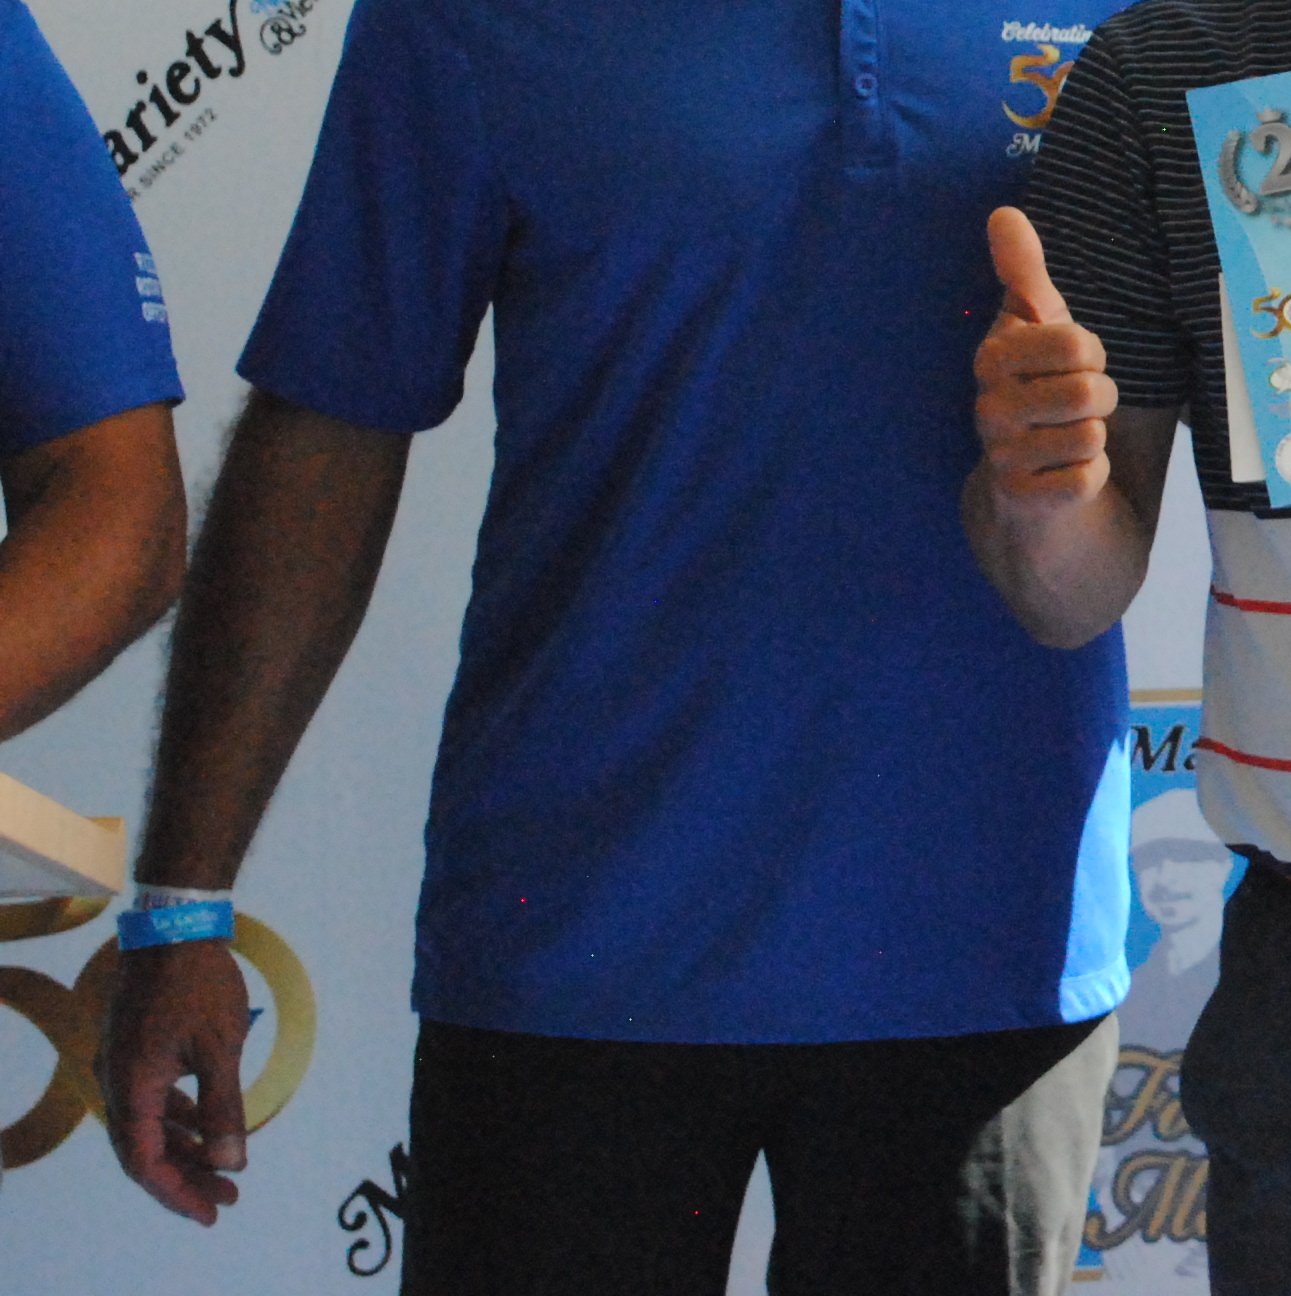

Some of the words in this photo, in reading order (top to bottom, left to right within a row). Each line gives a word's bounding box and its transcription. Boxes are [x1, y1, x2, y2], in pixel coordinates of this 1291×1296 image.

[1001, 21, 1094, 43] Celebratin
[139, 144, 185, 189] SINCE
[183, 107, 218, 142] 1972
